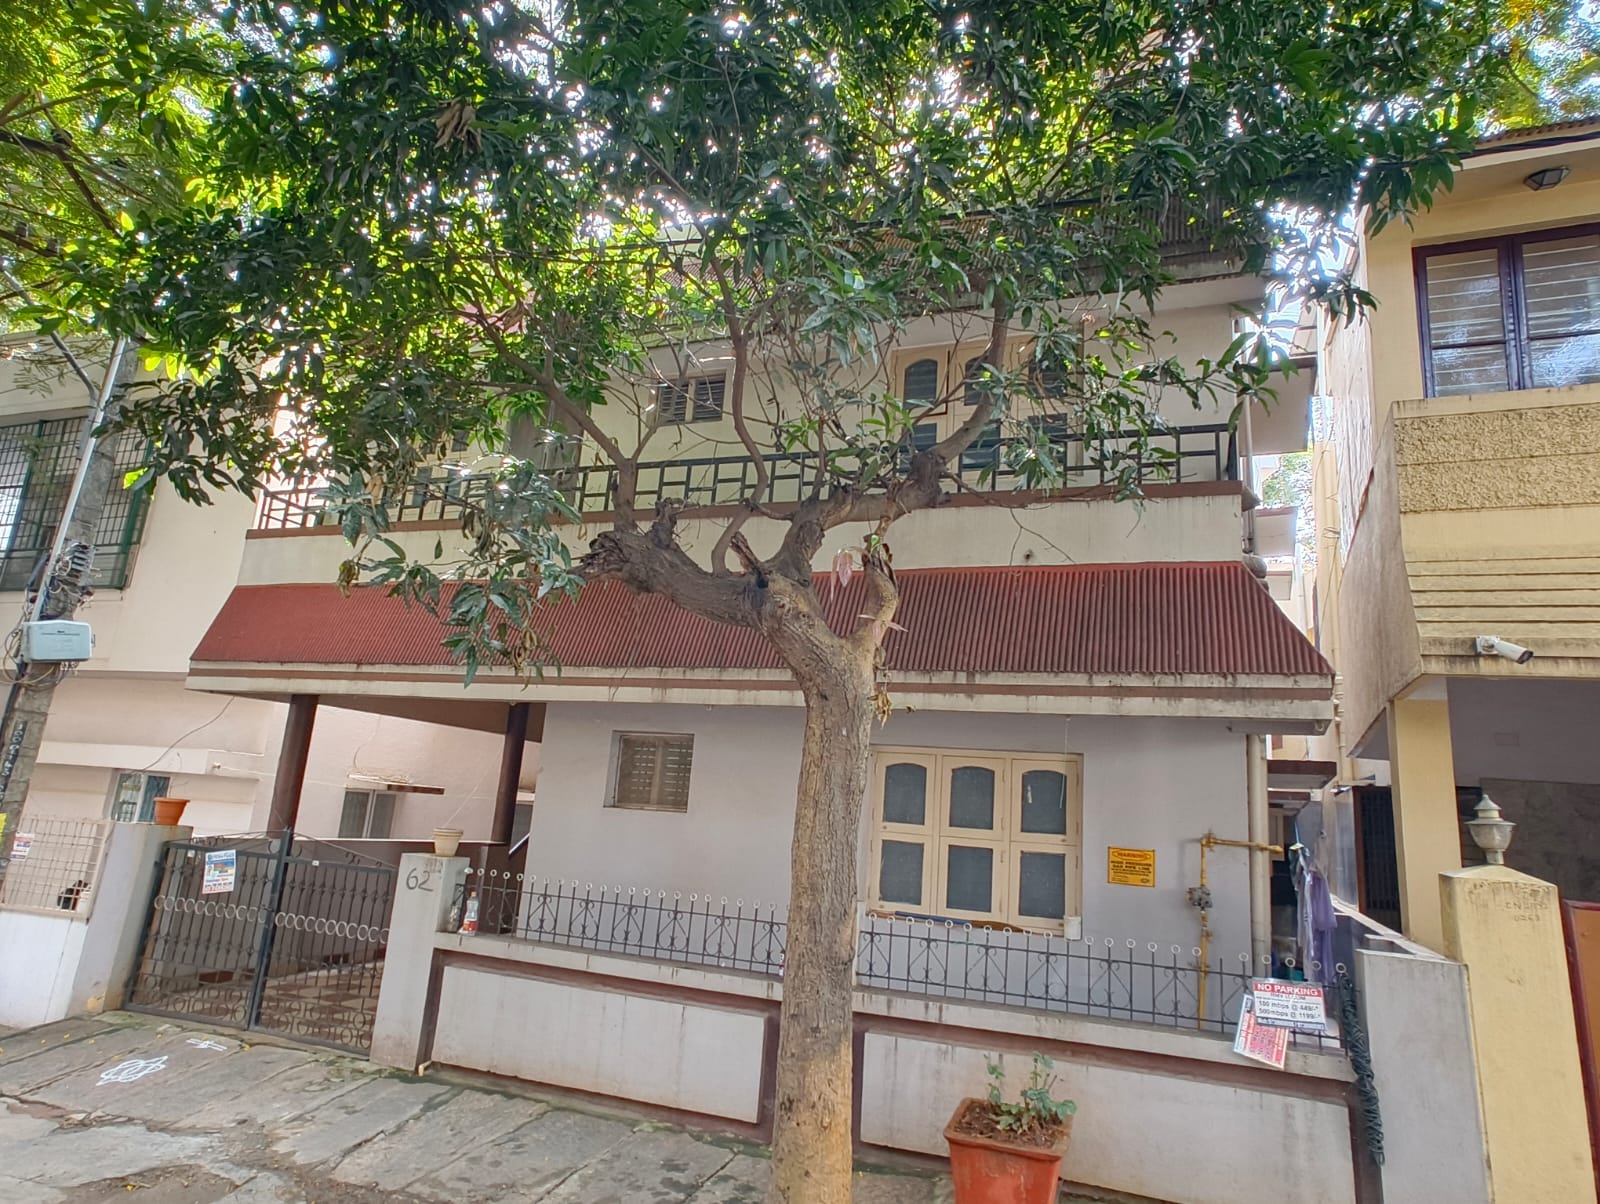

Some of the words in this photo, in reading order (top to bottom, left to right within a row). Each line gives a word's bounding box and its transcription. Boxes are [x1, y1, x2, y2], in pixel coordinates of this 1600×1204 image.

[406, 868, 433, 892] 62
[1257, 983, 1272, 992] NO
[1274, 985, 1318, 996] PARKING
